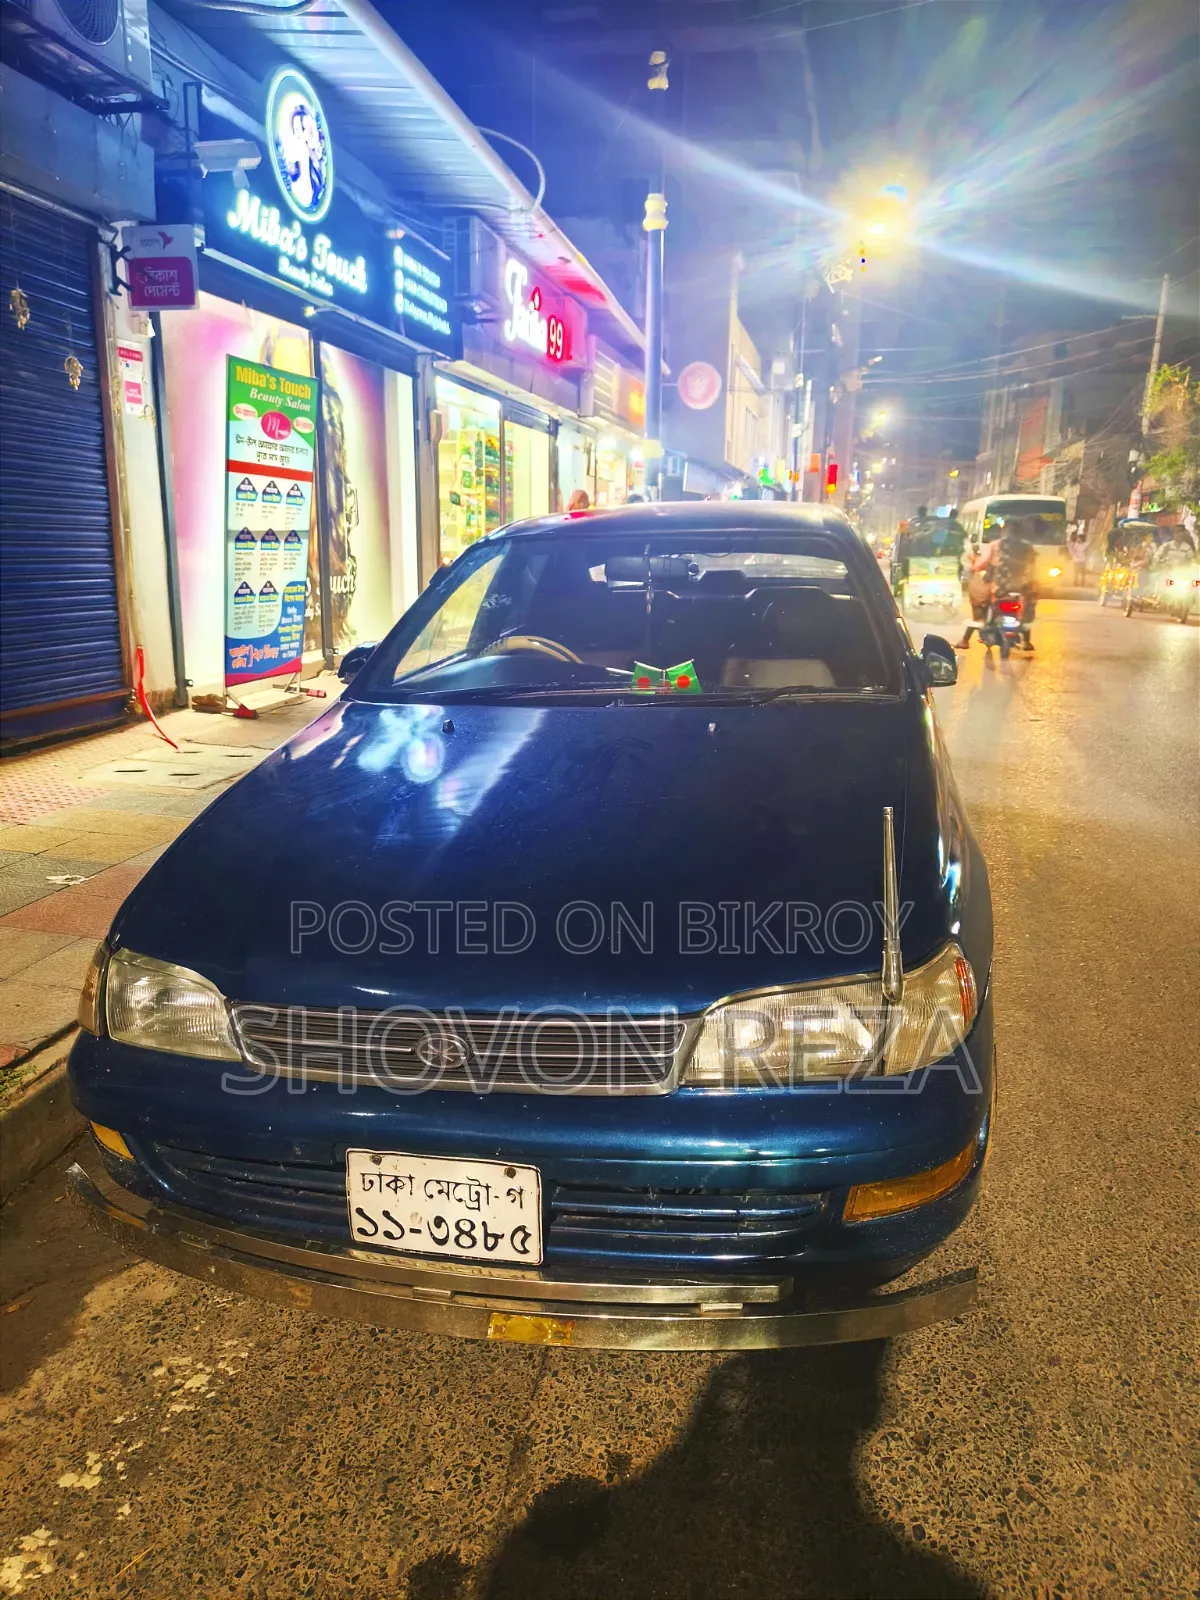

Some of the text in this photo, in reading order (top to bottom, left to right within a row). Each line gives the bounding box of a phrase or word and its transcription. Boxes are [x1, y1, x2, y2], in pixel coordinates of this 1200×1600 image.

[227, 189, 307, 261] Miba's
[312, 232, 367, 293] Touch
[549, 315, 564, 360] 99
[236, 366, 311, 399] Miba's Touch
[250, 388, 311, 412] Beauty Salon
[360, 1171, 415, 1196] ঢাকা
[355, 1206, 533, 1255] ১১-৩৪৮৫
